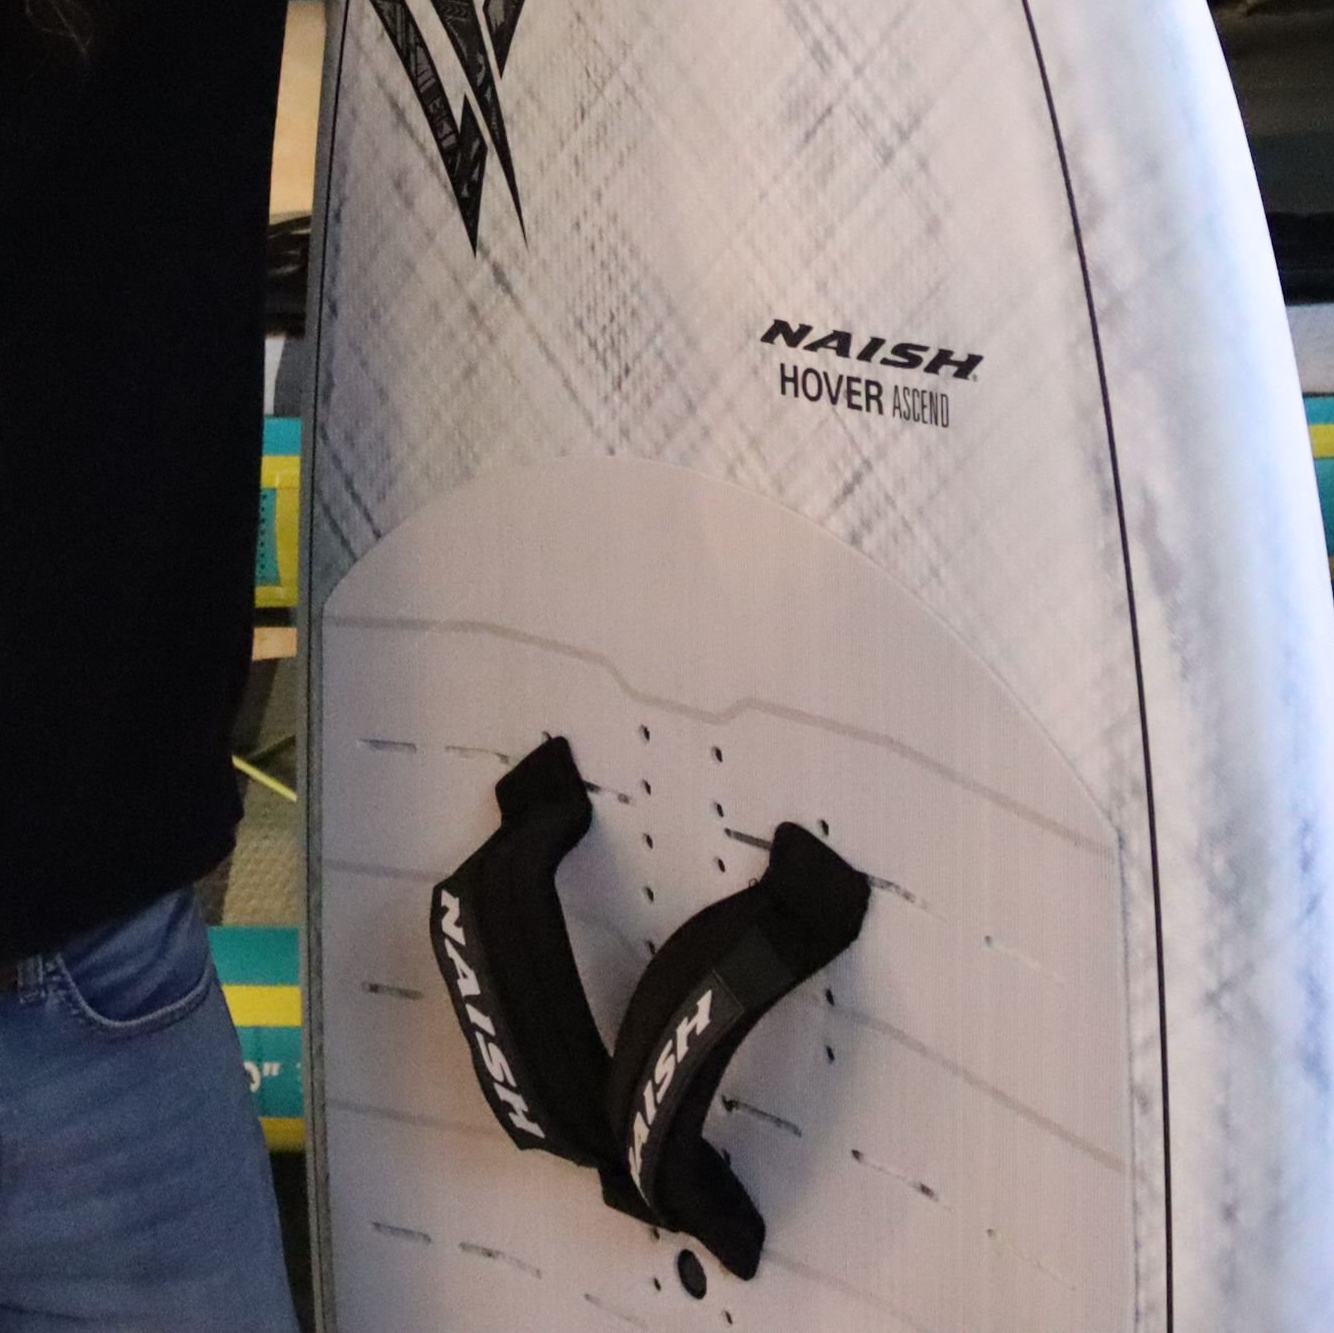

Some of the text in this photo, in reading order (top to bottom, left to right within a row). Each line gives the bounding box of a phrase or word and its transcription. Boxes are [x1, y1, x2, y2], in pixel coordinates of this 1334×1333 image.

[760, 319, 984, 381] NAISH
[780, 363, 950, 428] HOVER ASCEND
[440, 889, 546, 1140] NAISH
